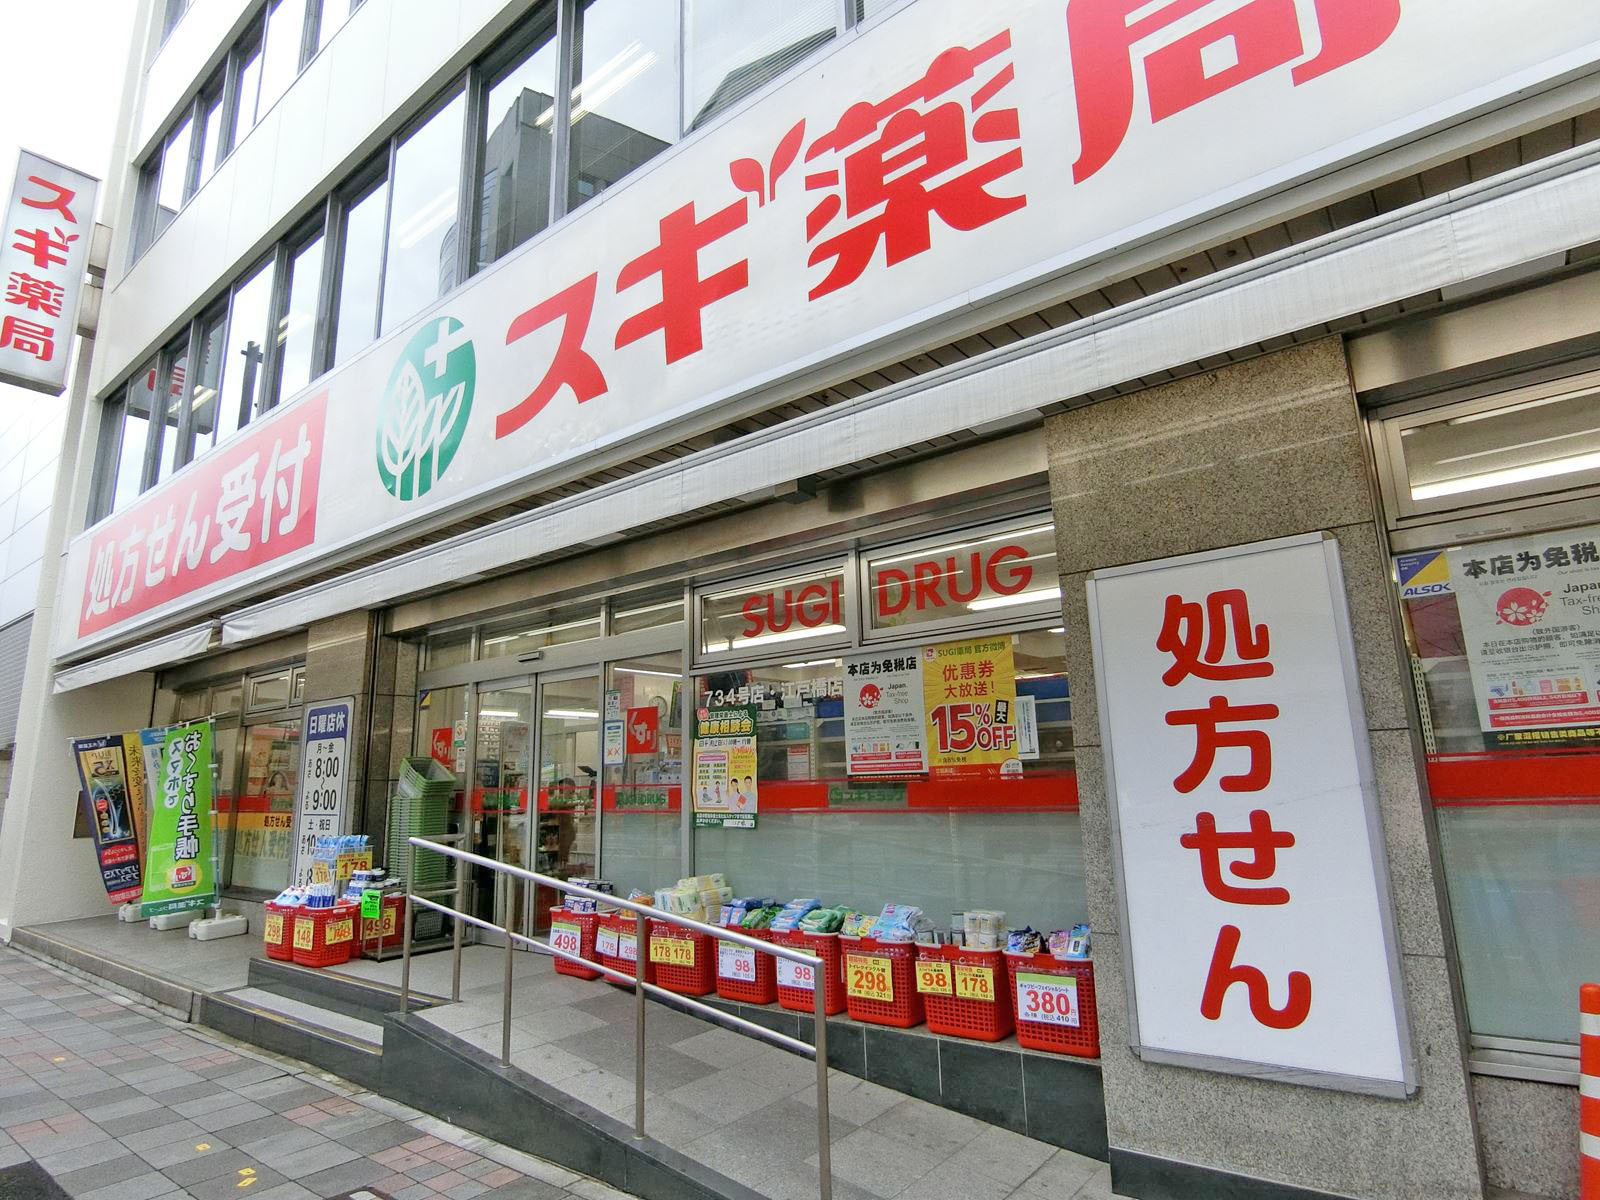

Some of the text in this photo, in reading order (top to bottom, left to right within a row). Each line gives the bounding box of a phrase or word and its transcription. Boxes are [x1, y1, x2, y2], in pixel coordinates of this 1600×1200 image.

[495, 0, 1401, 440] スギ薬局
[0, 175, 80, 361] スギ薬局
[85, 424, 311, 619] 処方せん受付
[1462, 541, 1600, 579] 本店为免税
[742, 545, 1033, 638] SUGI DRUG
[1404, 583, 1451, 596] ALSOK
[848, 656, 917, 676] 本店为免税店
[942, 659, 994, 682] 优惠券
[997, 701, 1007, 722] 最大
[309, 712, 346, 734] 日曜店休
[977, 725, 1016, 750] OFF
[315, 757, 339, 778] 8:00
[313, 790, 337, 811] 9:00
[1156, 589, 1312, 1030] 処方せん
[297, 929, 311, 943] 148
[554, 934, 577, 951] 498
[602, 940, 615, 951] 178
[653, 945, 671, 958] 178
[674, 948, 691, 961] 178
[735, 959, 750, 972] 98
[795, 966, 811, 980] 98
[854, 969, 887, 993] 298
[922, 972, 947, 987] 98
[962, 977, 989, 993] 178
[1026, 989, 1070, 1015] 380
